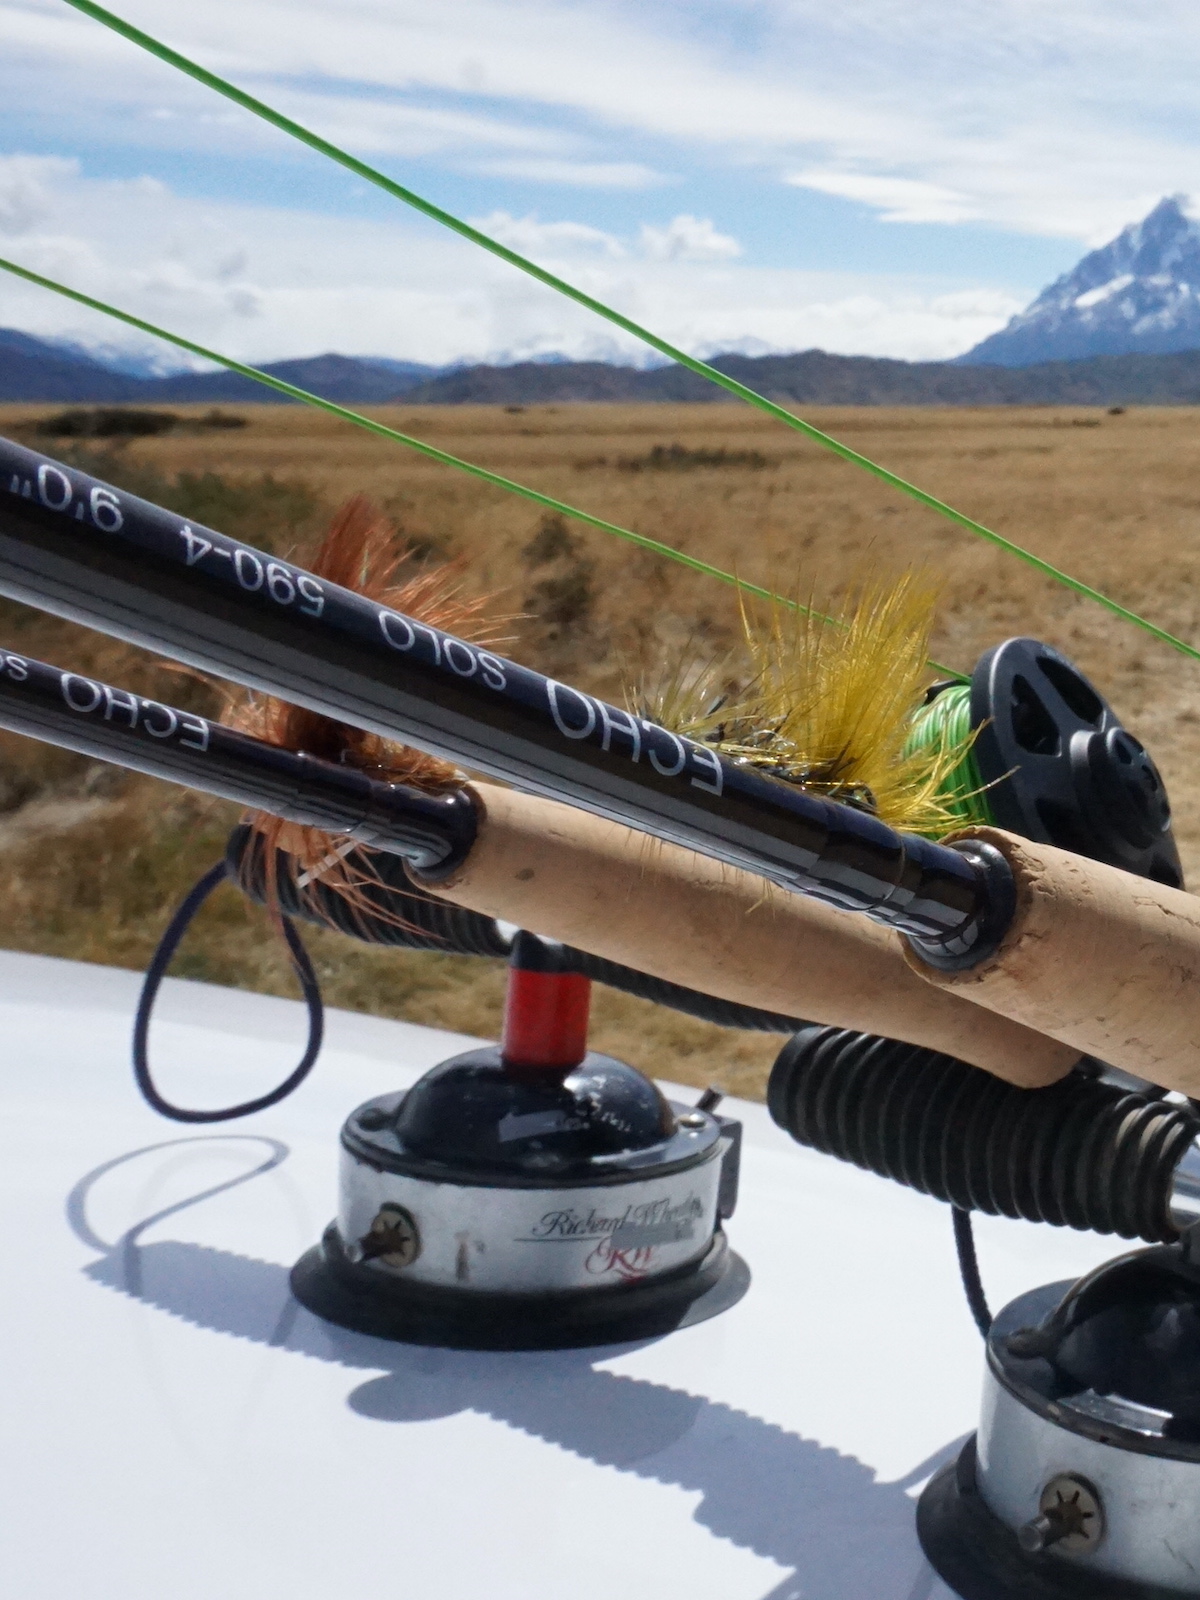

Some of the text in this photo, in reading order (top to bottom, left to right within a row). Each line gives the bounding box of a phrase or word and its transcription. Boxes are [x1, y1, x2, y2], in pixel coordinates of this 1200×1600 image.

[180, 524, 325, 618] 590-4
[379, 609, 506, 691] SOLO
[60, 672, 210, 752] ECHO
[546, 679, 723, 796] ECHO
